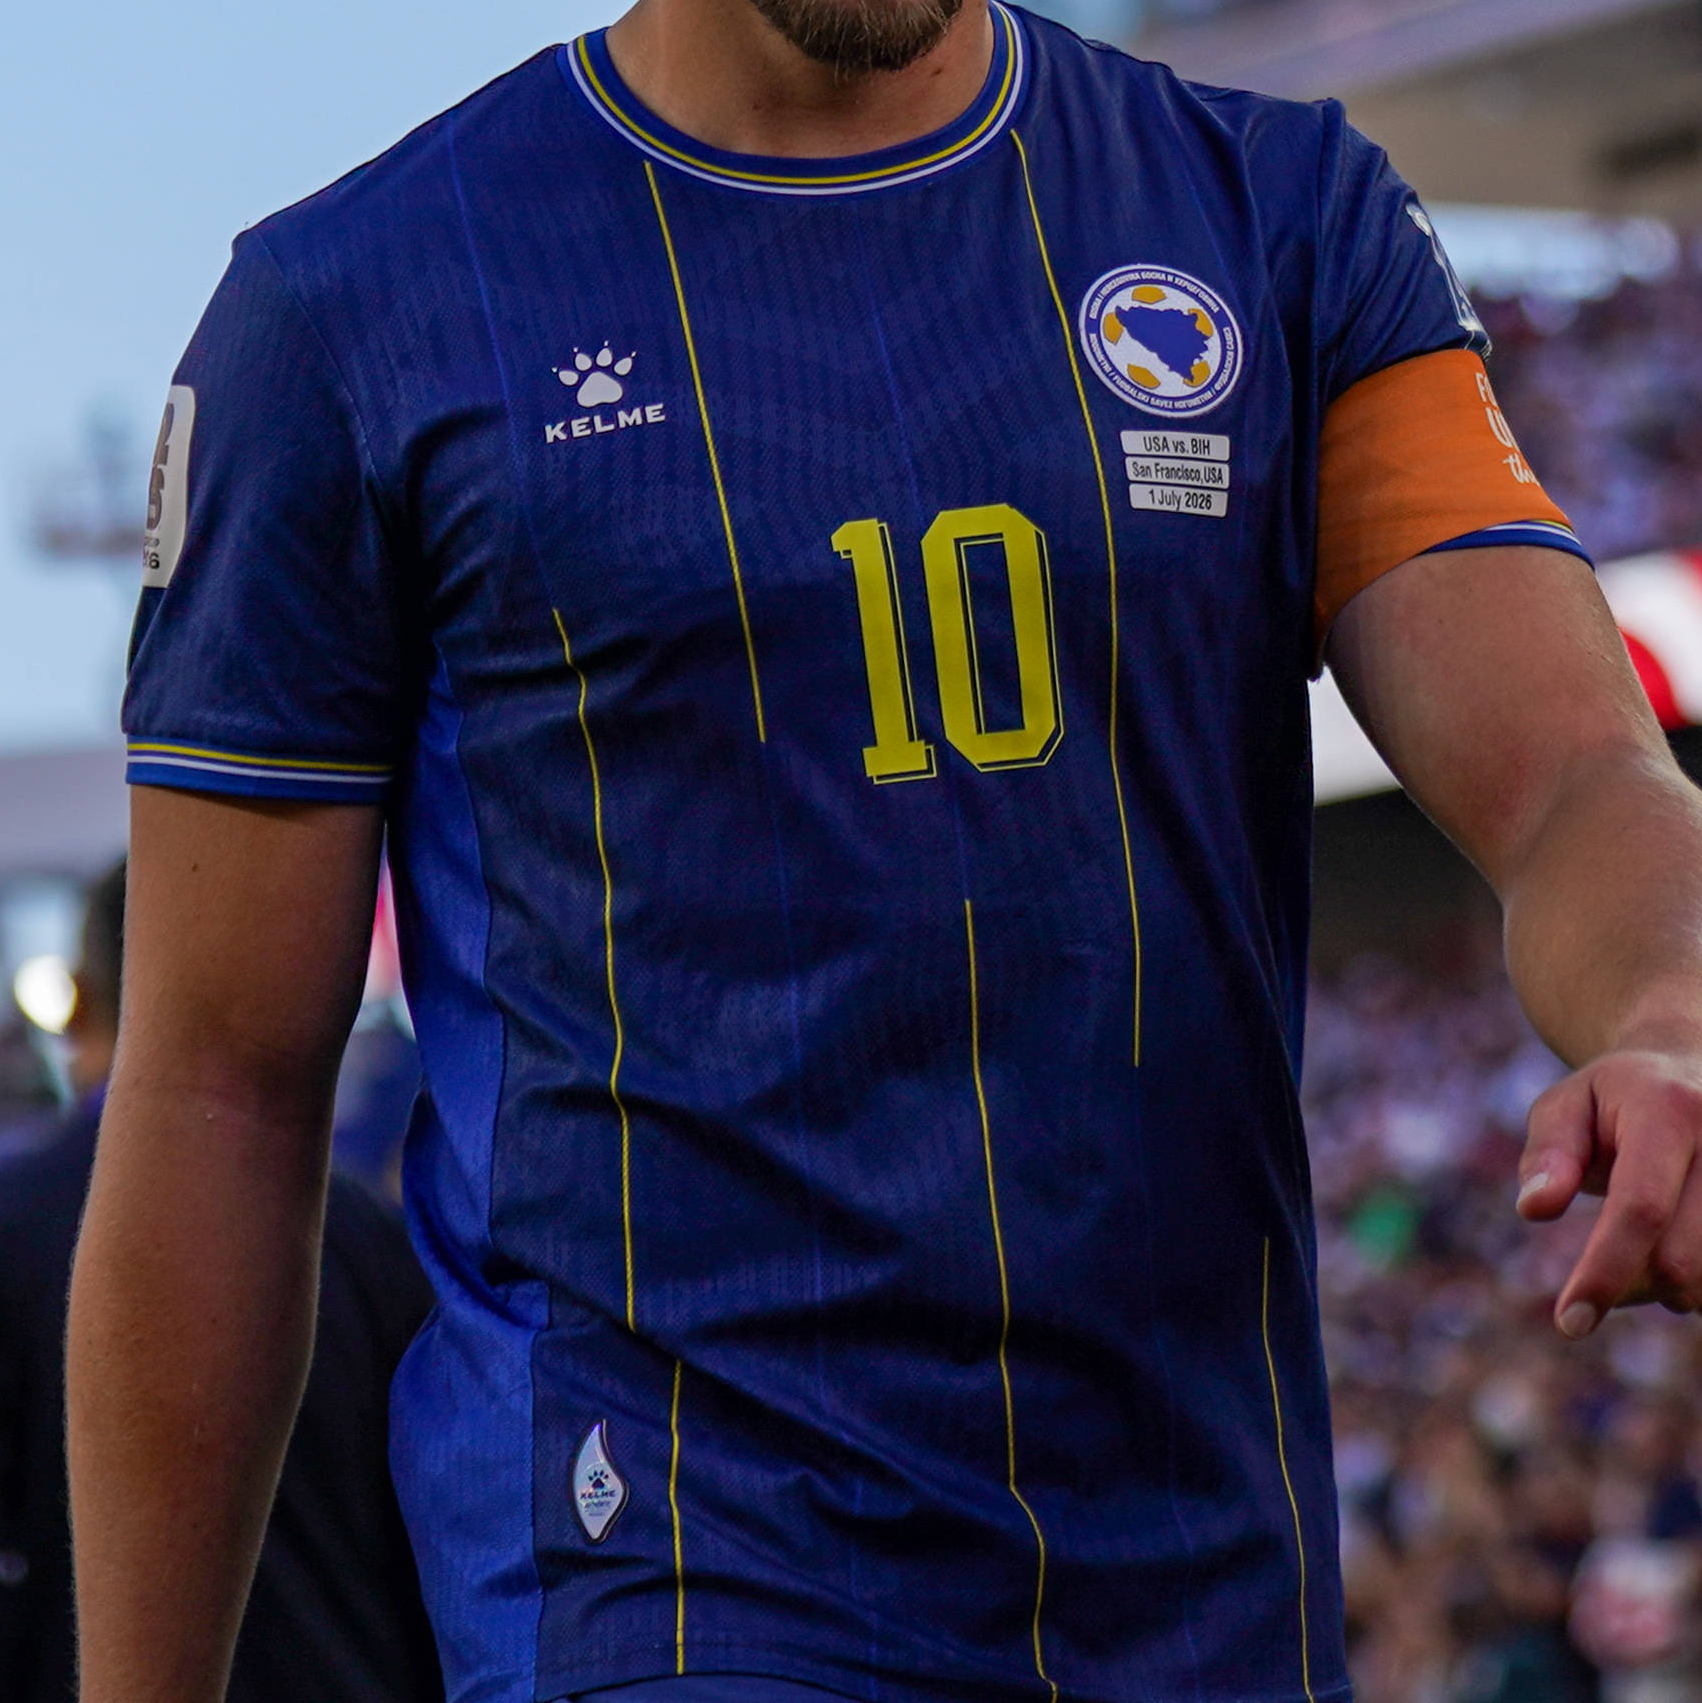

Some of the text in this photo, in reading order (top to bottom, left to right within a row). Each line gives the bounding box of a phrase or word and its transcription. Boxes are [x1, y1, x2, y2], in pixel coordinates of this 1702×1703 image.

[545, 403, 666, 443] KELME
[1143, 436, 1211, 456] USA vs. BIH
[1132, 461, 1152, 478] San
[1149, 489, 1212, 511] 1 July 2026
[830, 503, 1064, 785] 10
